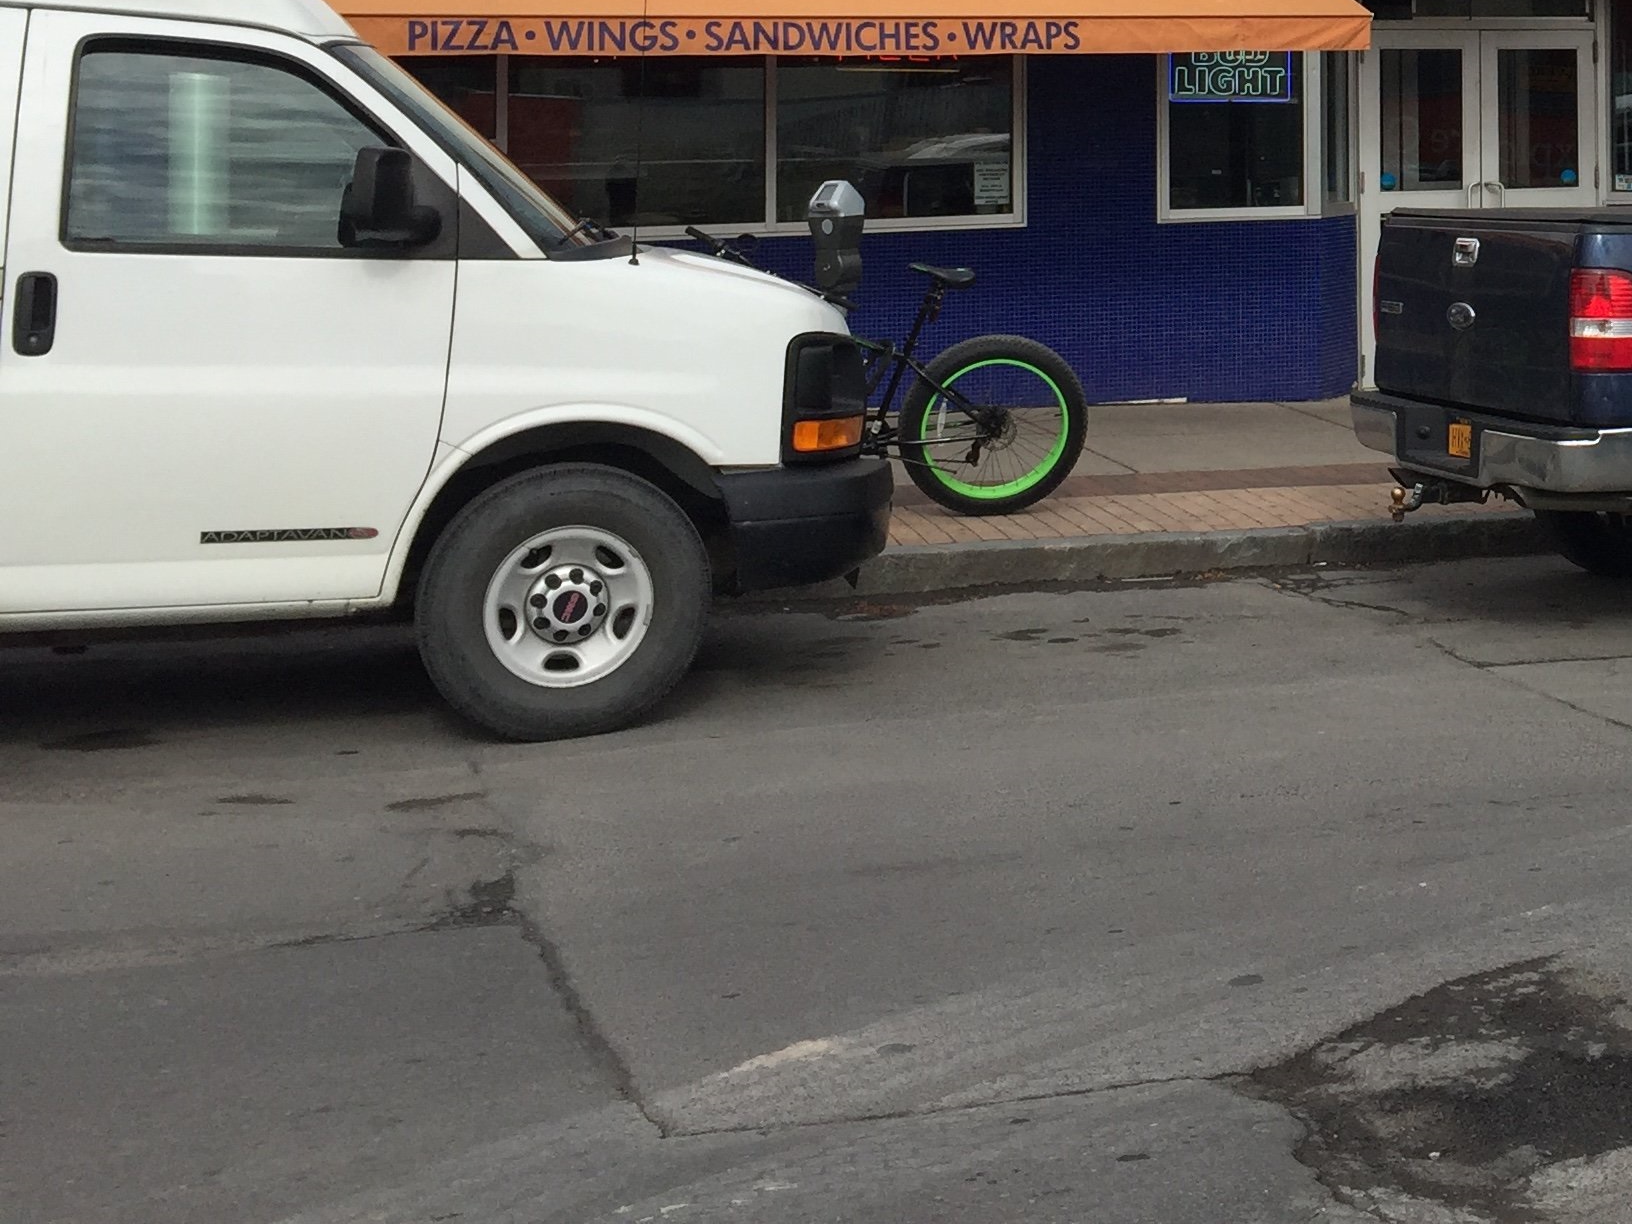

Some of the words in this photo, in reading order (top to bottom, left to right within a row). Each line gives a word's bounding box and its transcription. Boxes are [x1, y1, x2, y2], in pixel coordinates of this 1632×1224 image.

[407, 20, 519, 52] PIZZA
[544, 20, 679, 52] WINGS
[704, 20, 940, 52] SANDWICHES
[961, 21, 1081, 51] WRAPS
[1174, 66, 1286, 96] LIGHT
[201, 527, 347, 543] ADAPTAVAN
